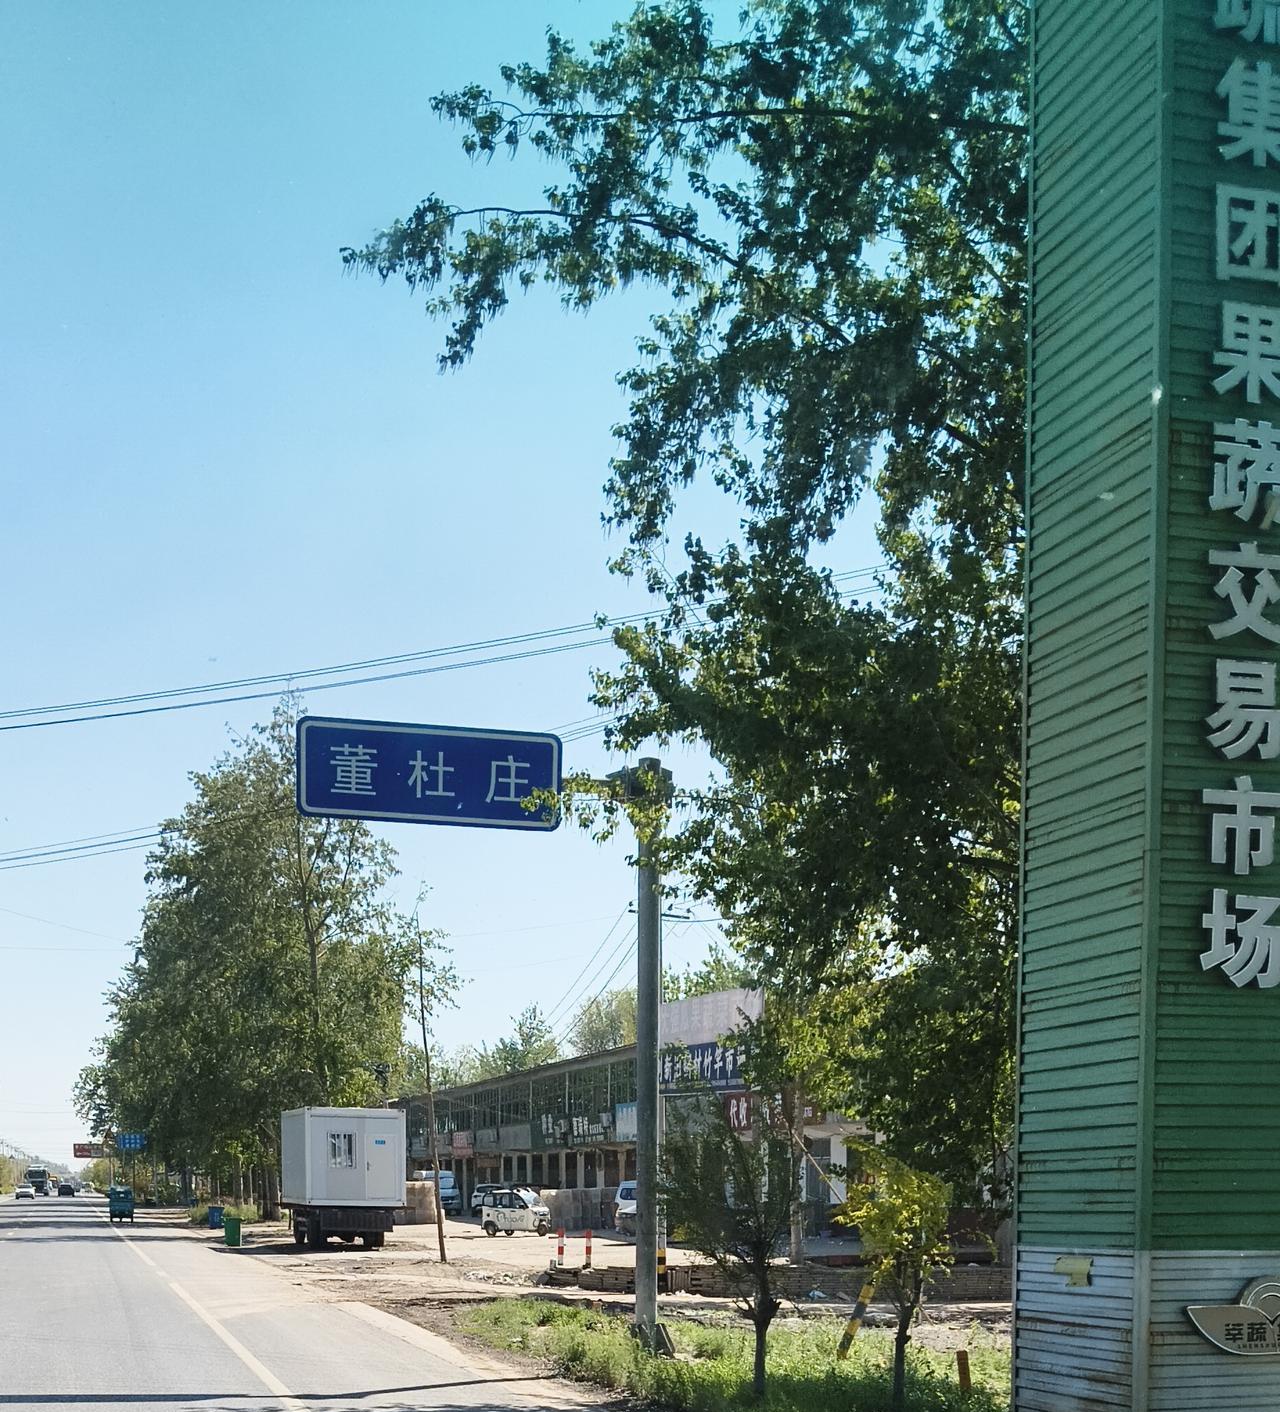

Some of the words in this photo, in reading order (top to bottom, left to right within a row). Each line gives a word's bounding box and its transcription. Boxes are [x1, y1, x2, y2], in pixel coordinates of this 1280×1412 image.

[330, 744, 531, 803] 董杜庄
[1225, 1322, 1280, 1343] 莘蔬
